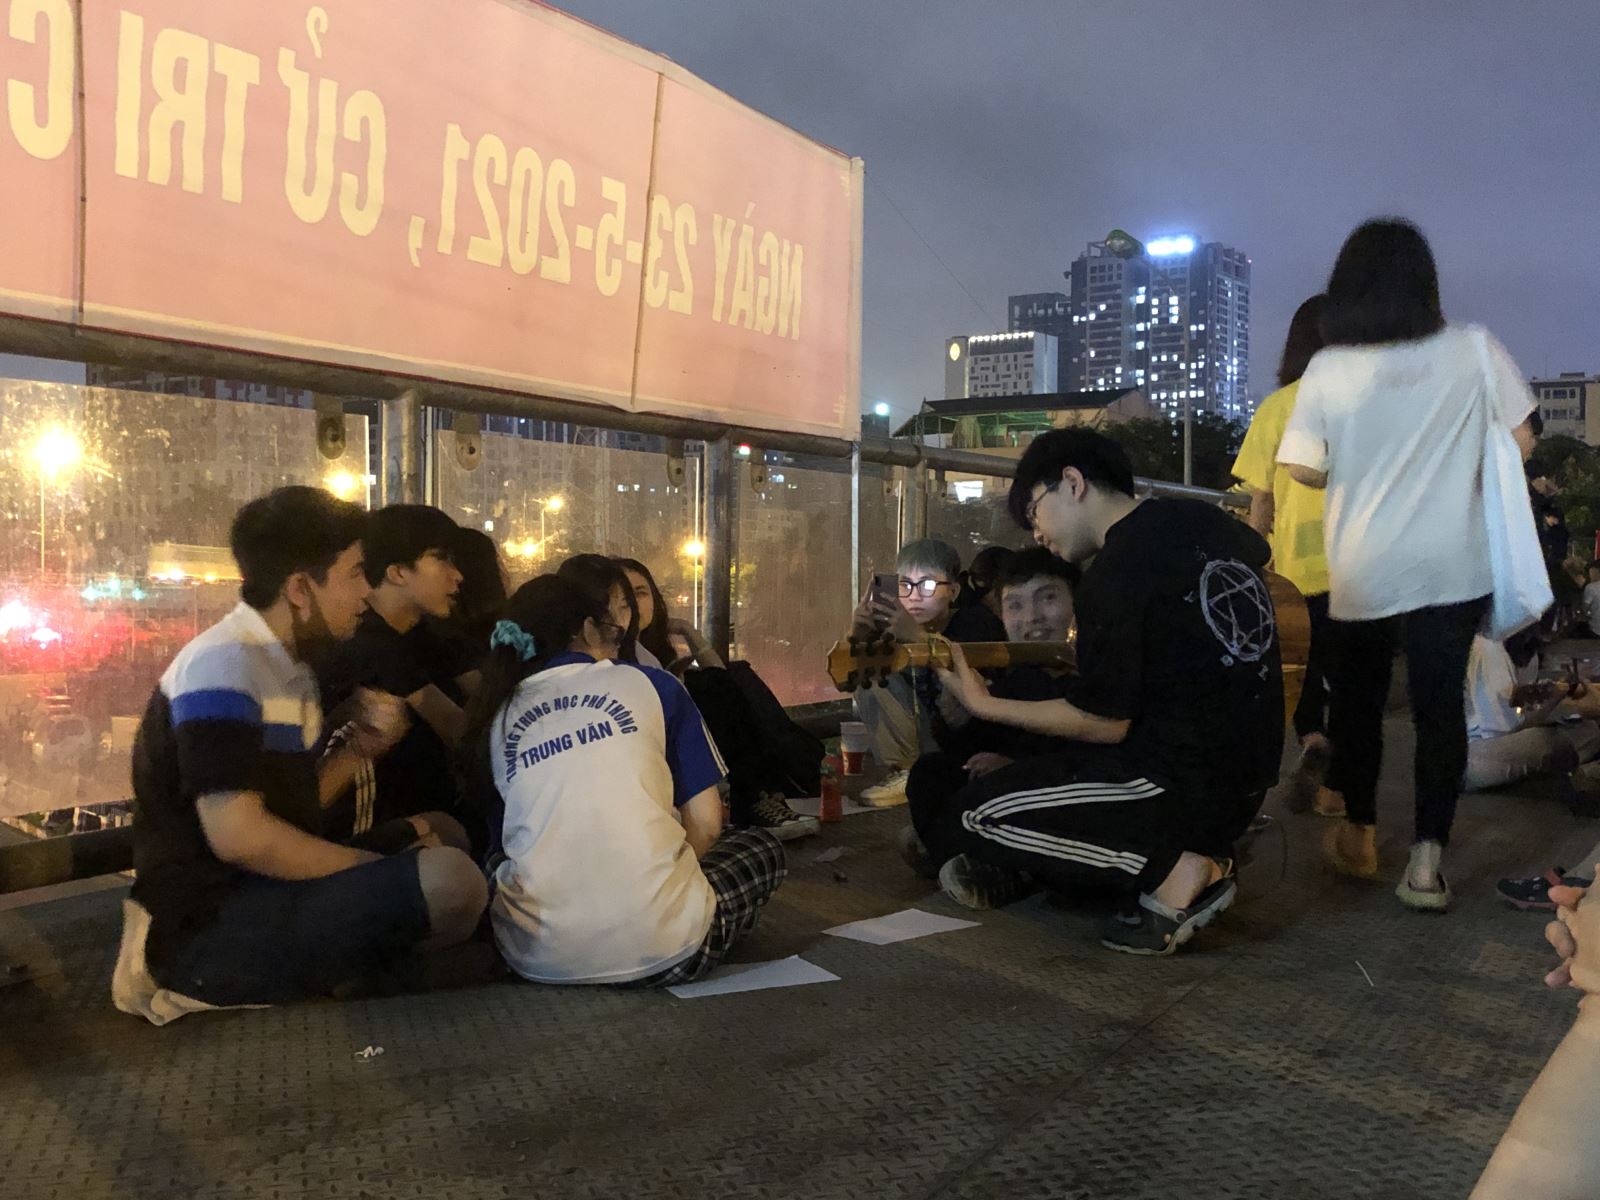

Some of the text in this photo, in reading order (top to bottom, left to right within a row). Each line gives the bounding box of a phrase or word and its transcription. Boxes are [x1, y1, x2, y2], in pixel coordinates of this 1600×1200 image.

[513, 702, 551, 732] TRUNG
[554, 694, 579, 712] HỌC
[520, 721, 614, 769] TRUNG VĂN
